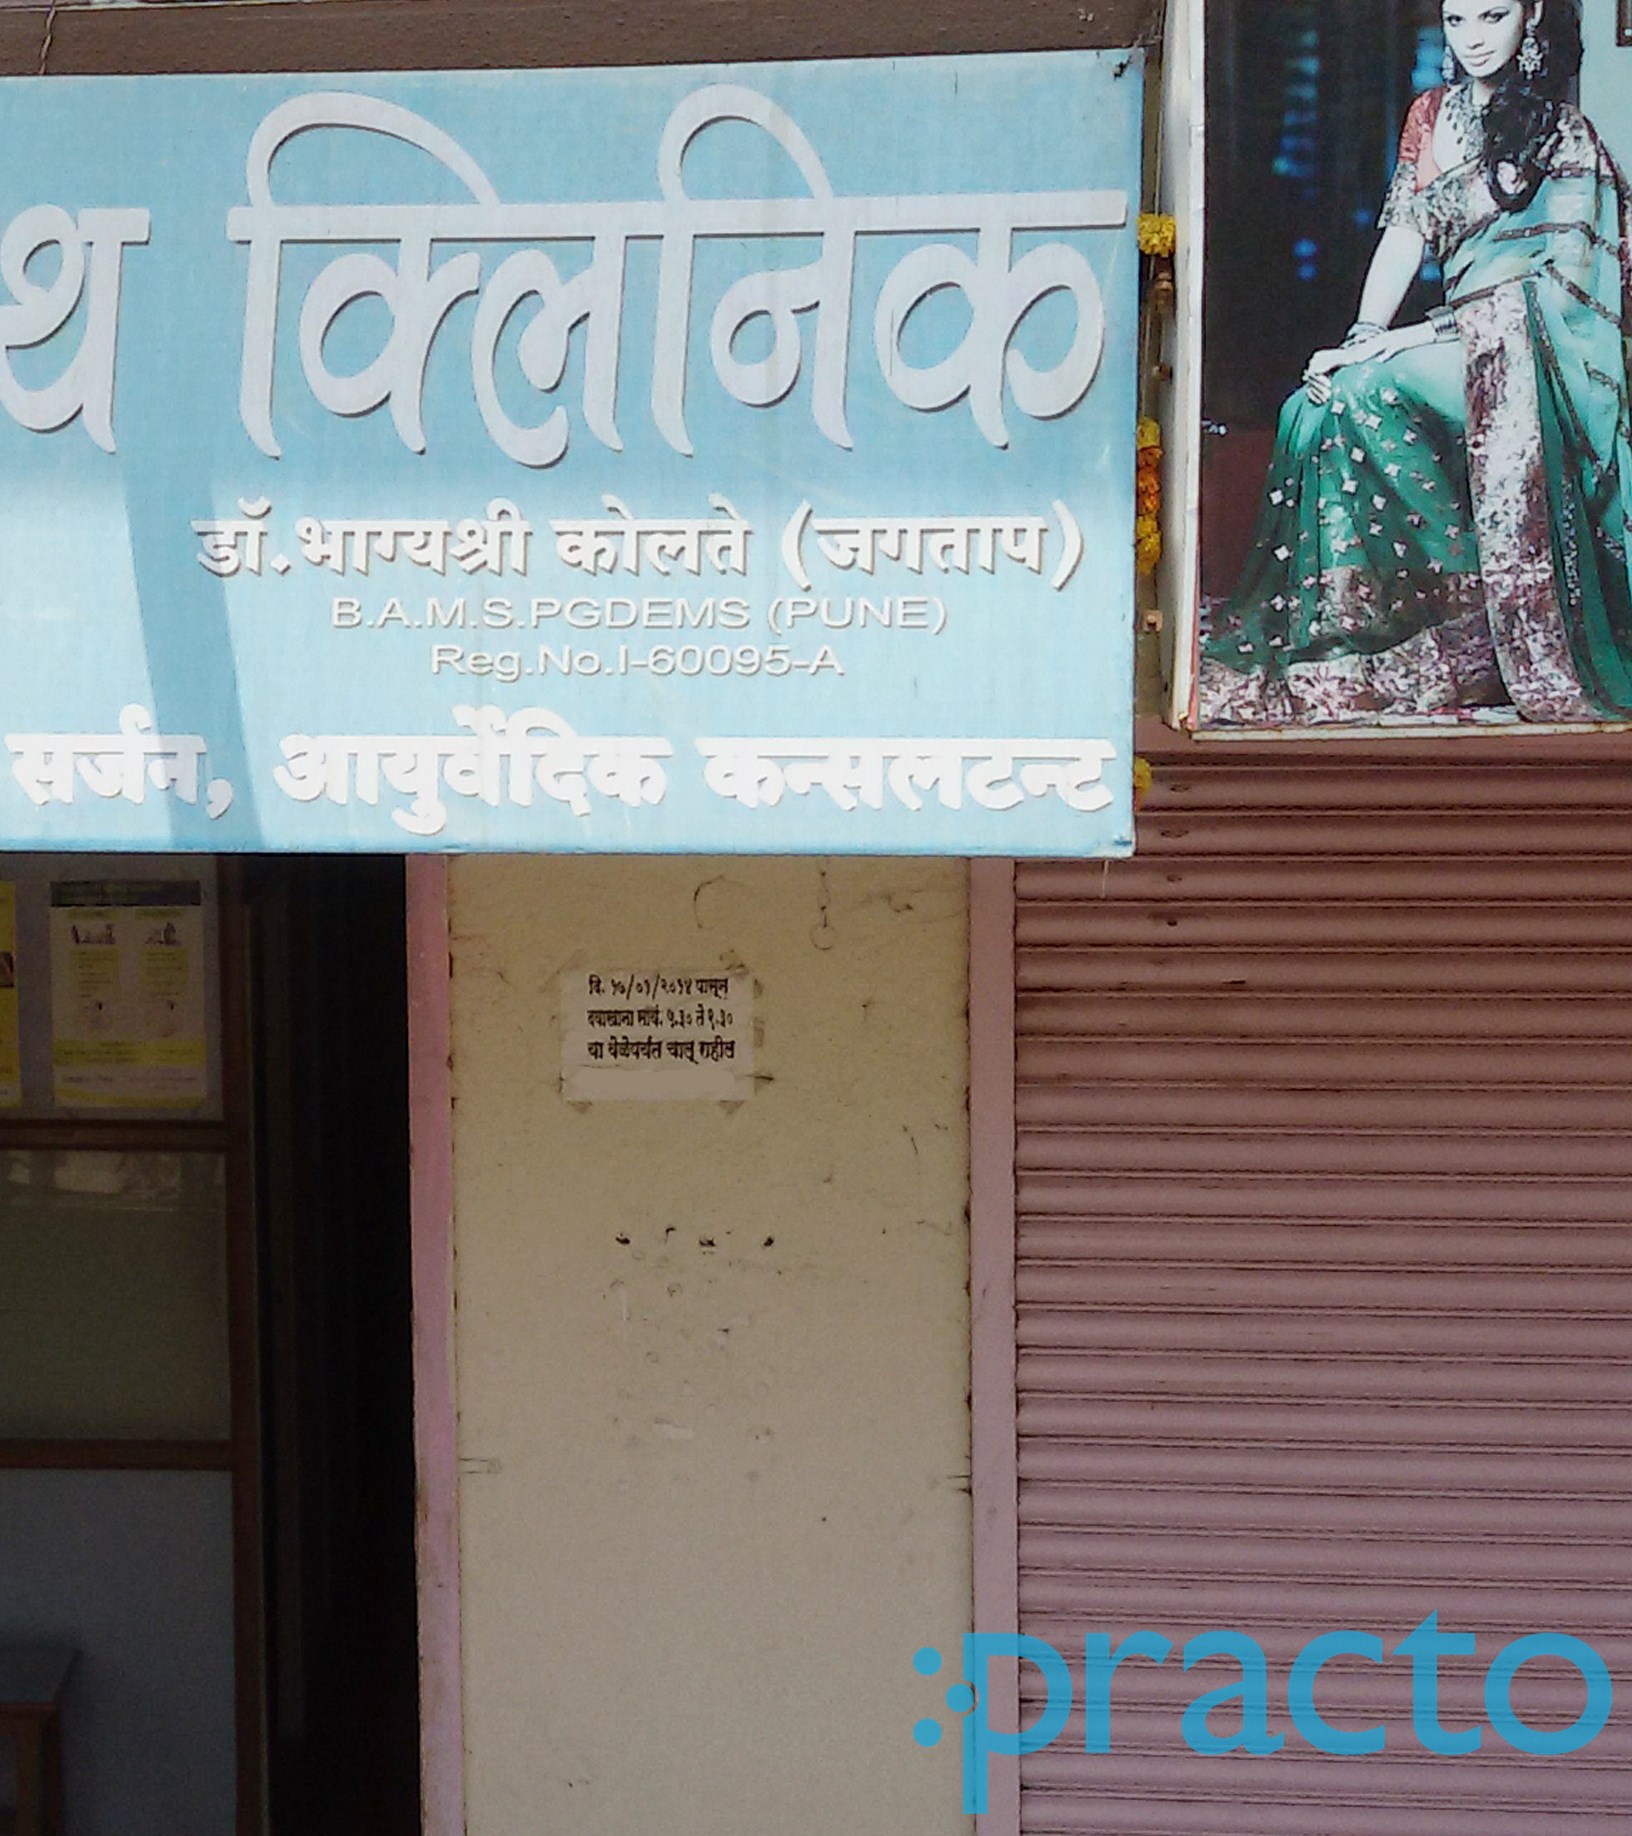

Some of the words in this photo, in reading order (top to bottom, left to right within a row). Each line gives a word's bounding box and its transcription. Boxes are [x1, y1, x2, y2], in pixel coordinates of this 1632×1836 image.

[226, 83, 1127, 468] क्लिनिक
[549, 493, 754, 577] कोलते
[781, 499, 1084, 591] (जगताप)
[329, 597, 752, 630] B.A.M.S.PGDEMS
[767, 597, 949, 634] (PUNE)
[4, 703, 234, 819] सर्जन,
[273, 703, 673, 835] आयुर्वेदिक
[695, 734, 1117, 812] कन्सलटन्ट
[587, 1010, 634, 1027] दवाखाना
[695, 1003, 705, 1026] ते
